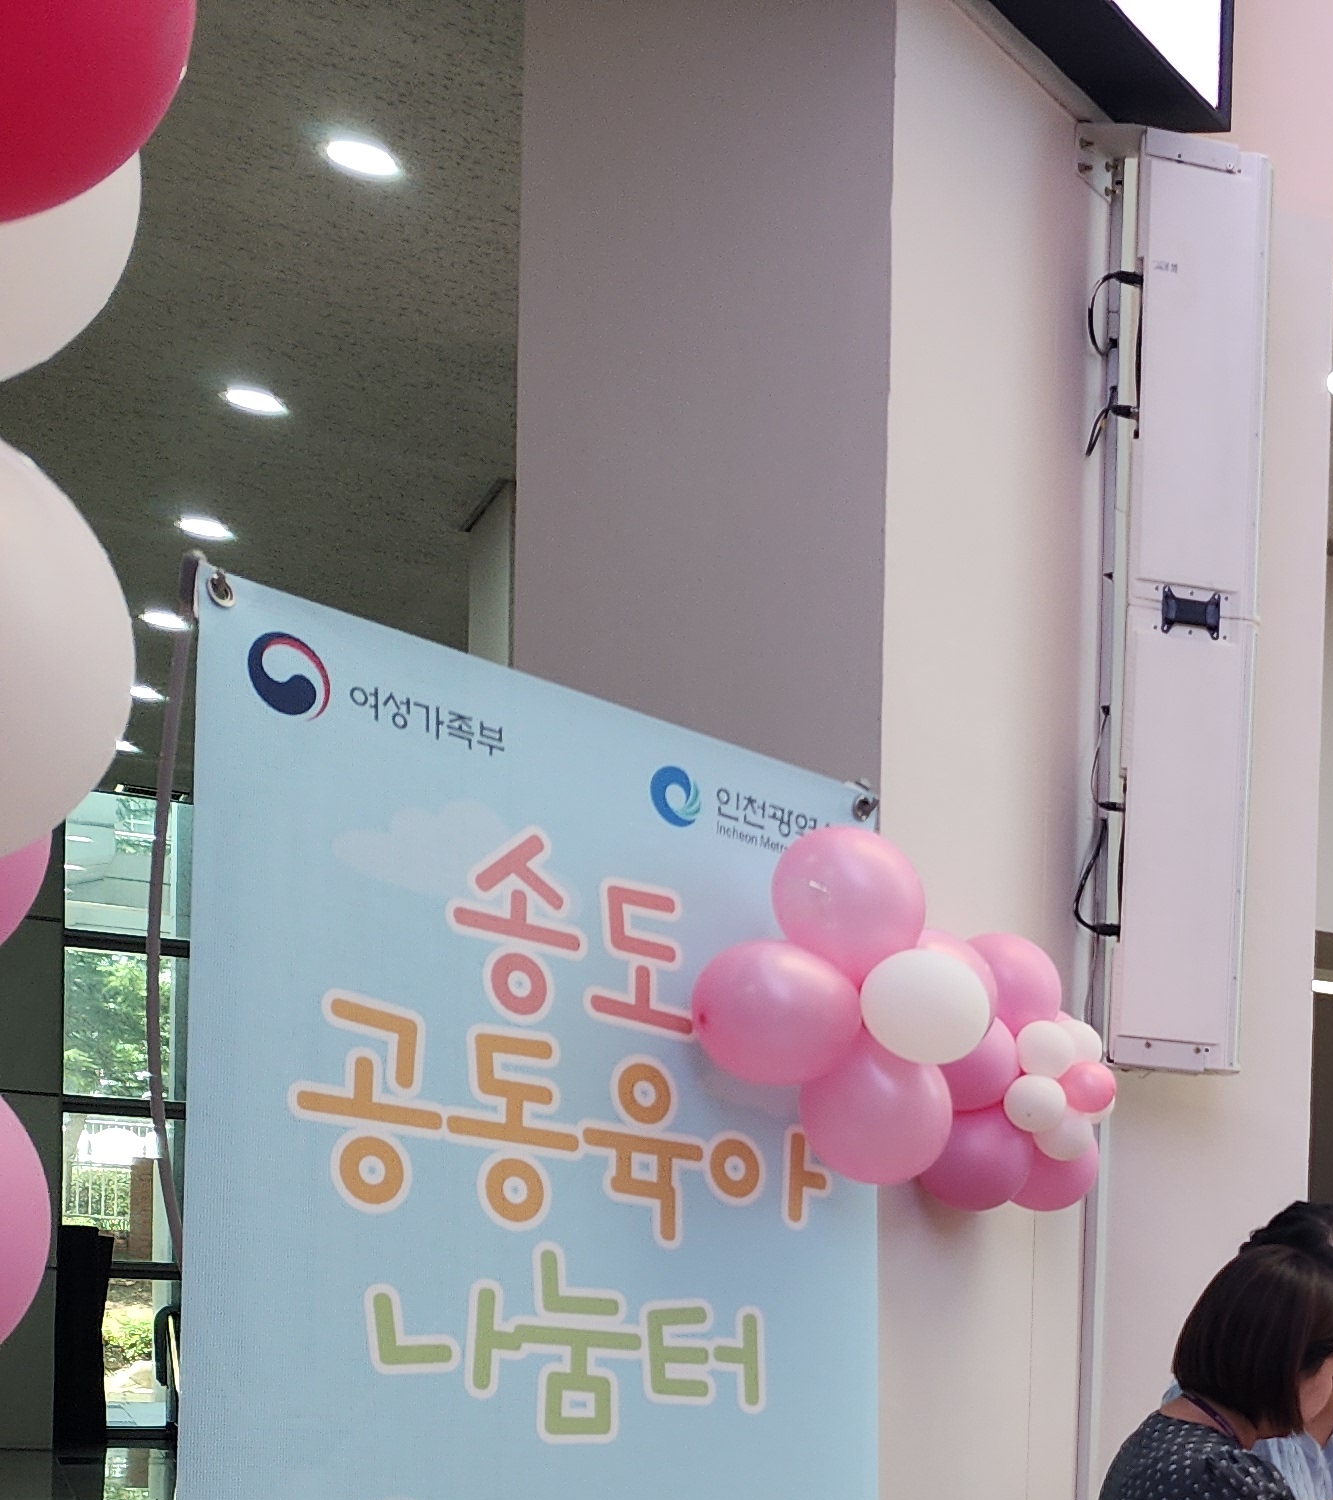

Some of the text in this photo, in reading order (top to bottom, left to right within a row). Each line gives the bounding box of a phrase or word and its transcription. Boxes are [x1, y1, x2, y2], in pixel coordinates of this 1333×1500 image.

[350, 685, 506, 755] 여성가족부
[716, 821, 758, 847] Incheon
[717, 788, 821, 837] 인천광역
[449, 830, 694, 1038] 송도
[295, 996, 830, 1244] 공동육아
[371, 1248, 761, 1437] 나눔터
